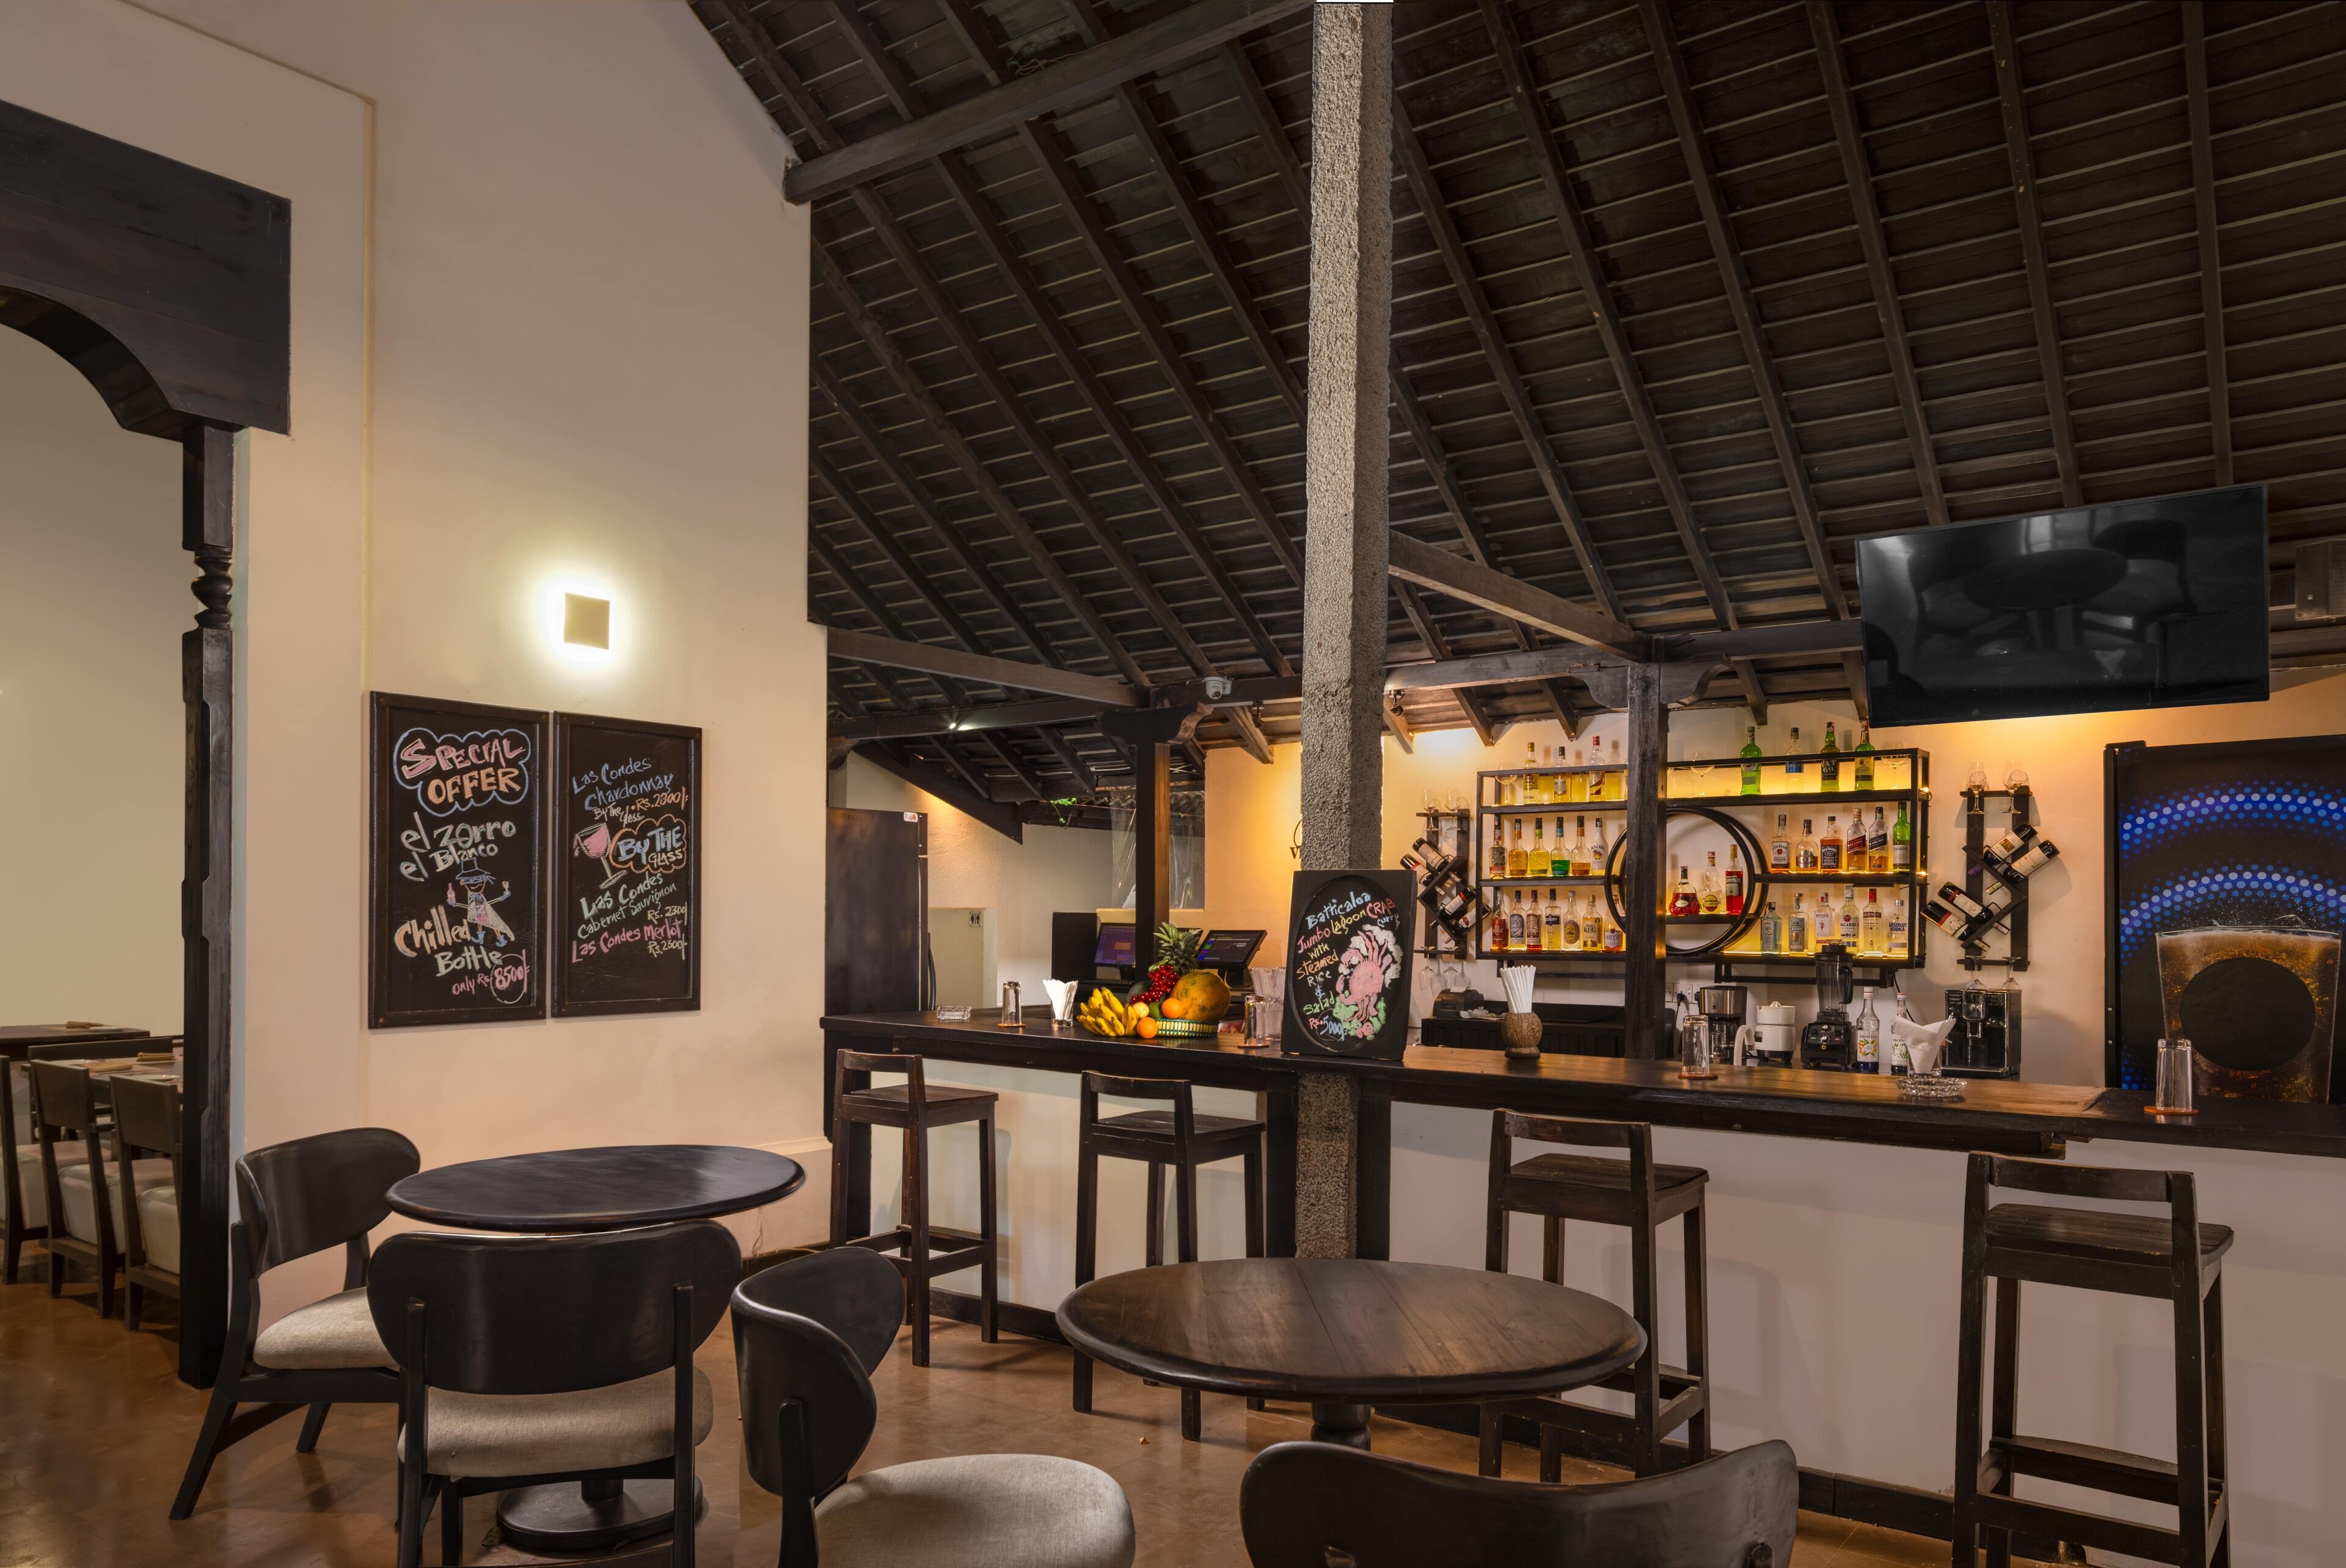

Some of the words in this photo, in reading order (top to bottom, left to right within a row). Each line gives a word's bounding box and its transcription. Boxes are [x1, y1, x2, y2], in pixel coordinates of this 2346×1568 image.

[400, 738, 526, 779] SPECIAL
[572, 771, 599, 795] Las
[601, 757, 652, 786] Condes
[428, 767, 521, 804] OFFER
[585, 773, 674, 811] Chardonnay
[400, 811, 431, 853] el
[646, 825, 683, 851] THE
[400, 850, 429, 882] el
[428, 843, 499, 872] Blanco
[648, 848, 683, 868] GLASS
[579, 891, 614, 919] Las
[618, 870, 663, 905] Condes
[1305, 891, 1372, 930] Batticaloa
[394, 904, 471, 958] Chilled
[577, 905, 628, 939] Cabernet
[1297, 926, 1331, 954] Jumbo
[1365, 897, 1396, 919] CRAB
[434, 944, 503, 977] Bottle
[572, 939, 597, 963] Las
[600, 927, 641, 953] Condes
